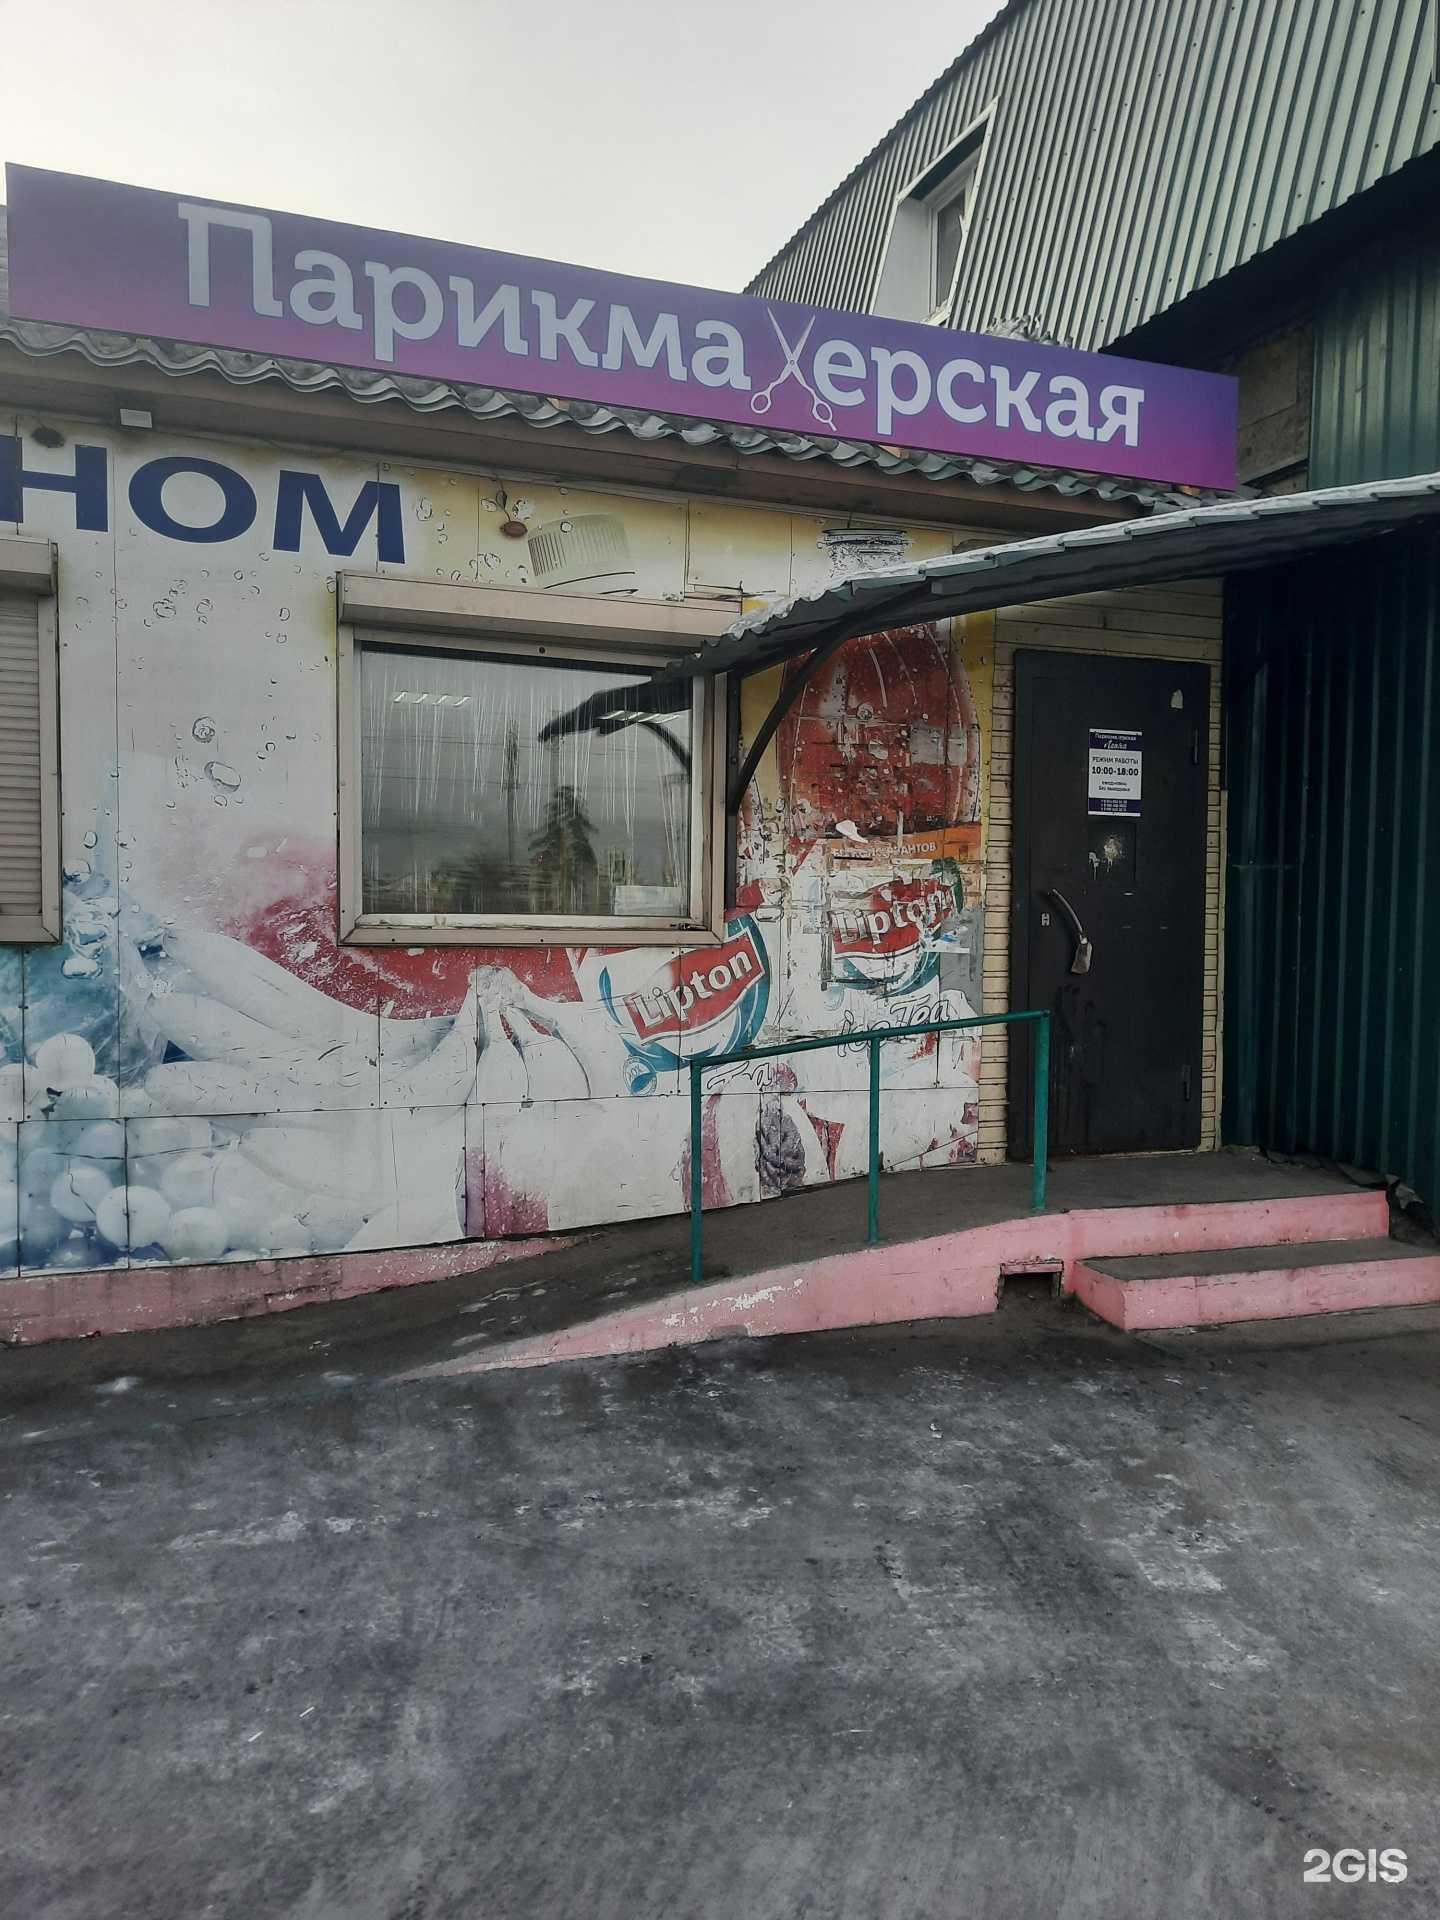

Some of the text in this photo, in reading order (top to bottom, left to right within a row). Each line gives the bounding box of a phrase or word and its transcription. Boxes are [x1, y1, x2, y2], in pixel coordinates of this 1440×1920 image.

[177, 202, 1145, 447] Парикмахерская
[1092, 766, 1139, 776] 10:00-18:00
[1114, 757, 1139, 765] РАБОТЫ
[832, 890, 953, 944] Lipton
[626, 950, 753, 1025] Lipton
